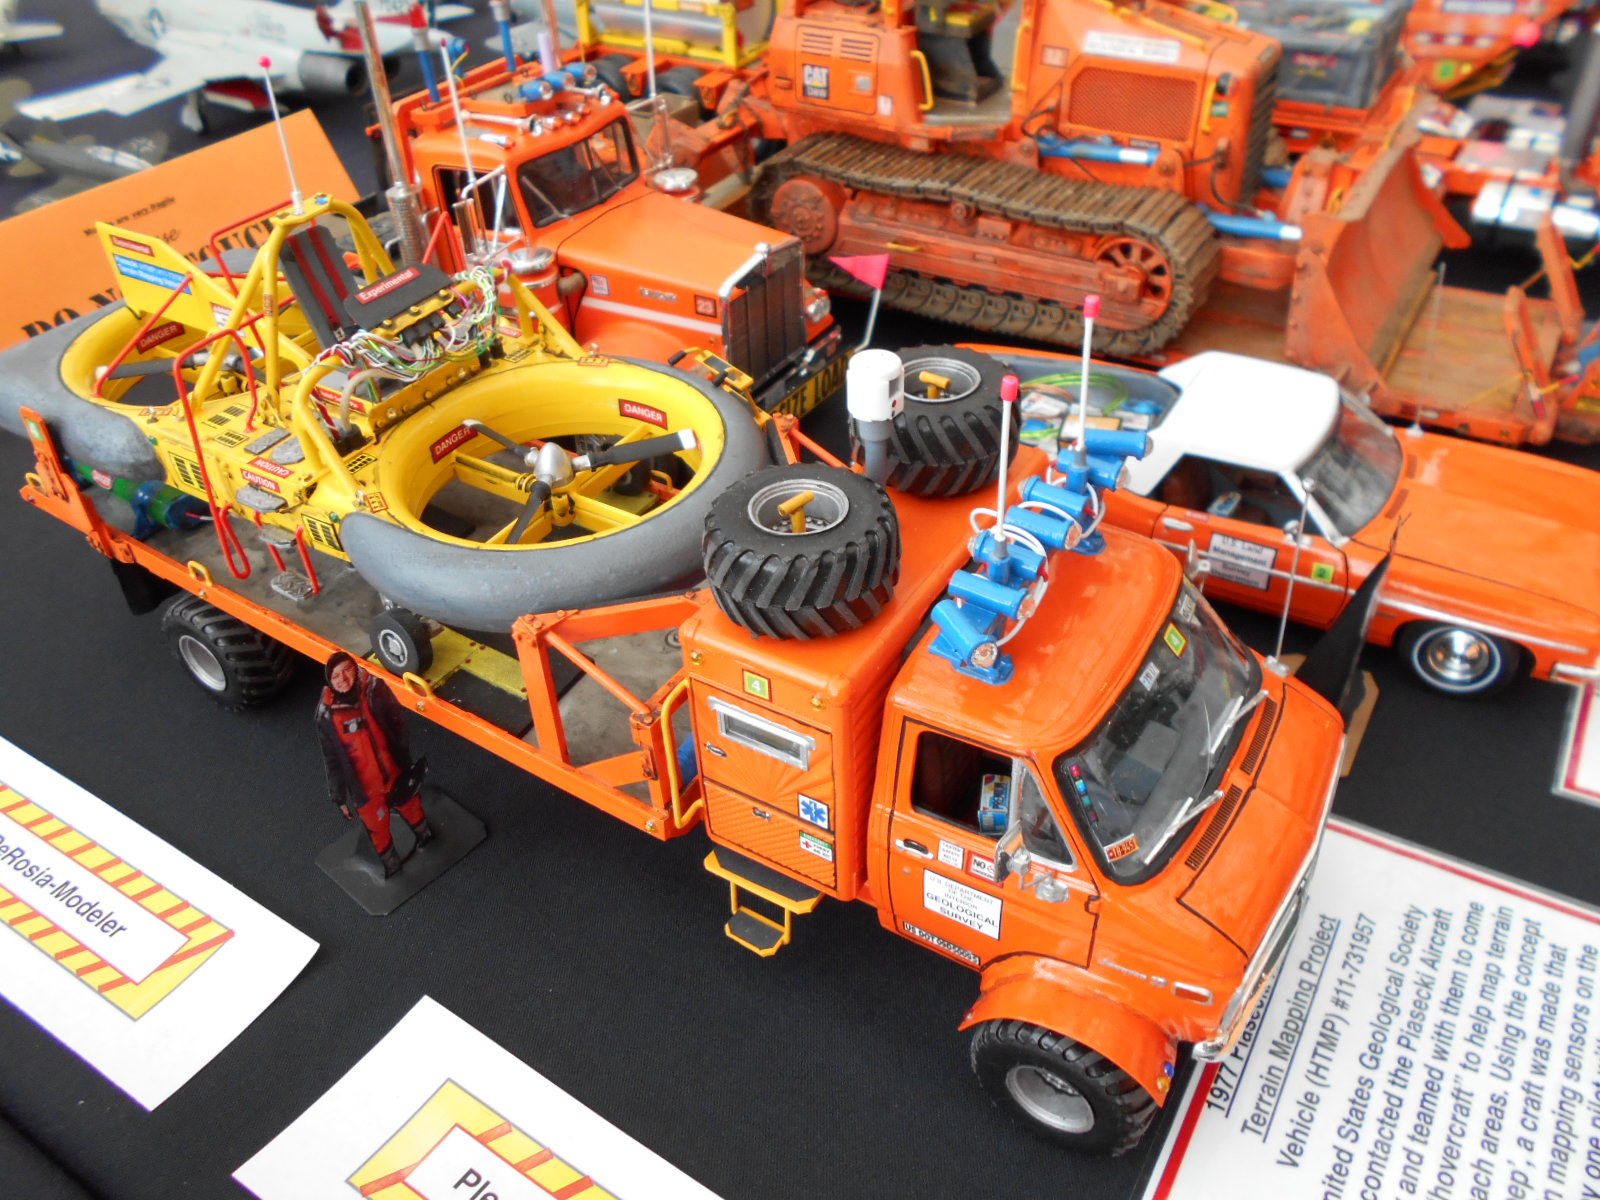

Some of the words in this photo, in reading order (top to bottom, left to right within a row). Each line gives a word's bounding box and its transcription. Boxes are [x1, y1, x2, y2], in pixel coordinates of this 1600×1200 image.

[803, 64, 829, 88] CAT
[360, 269, 414, 301] Experimental
[139, 325, 178, 348] DANGER
[624, 403, 663, 422] DANGER
[434, 427, 471, 455] DANGER
[242, 470, 276, 490] CAUTION
[255, 458, 290, 476] CAUTION
[1213, 546, 1267, 566] Management
[1241, 540, 1264, 554] Land
[751, 679, 761, 693] 4
[973, 858, 986, 869] NO
[926, 892, 998, 927] GEOLOGICAL
[944, 892, 978, 910] INTERIOR
[945, 879, 993, 905] DEPARTMENT
[904, 922, 917, 934] US
[919, 928, 936, 942] DOT
[940, 906, 983, 930] SURVEY
[1461, 901, 1485, 946] come
[1485, 905, 1514, 959] terrain
[1420, 907, 1454, 971] Aircraft
[1515, 917, 1544, 987] concept
[1452, 949, 1473, 967] to
[1543, 943, 1568, 979] that
[1576, 944, 1599, 973] the
[1439, 970, 1469, 1017] them
[1479, 961, 1505, 1002] map
[1576, 976, 1594, 1000] on
[1397, 970, 1437, 1052] Piasecki
[1503, 989, 1528, 1020] the
[1537, 982, 1561, 1034] made
[1240, 1063, 1285, 1136] Terrain
[1268, 977, 1318, 1062] Mapping
[1300, 913, 1337, 976] Project
[1276, 1090, 1321, 1168] Vehicle
[1305, 1012, 1350, 1088] (HTMP)
[1331, 912, 1376, 1011] #11-731957
[1337, 1076, 1374, 1144] States
[1358, 964, 1405, 1071] Geological
[1389, 904, 1428, 966] Society
[1431, 1019, 1456, 1062] with
[1464, 1004, 1496, 1048] help
[1490, 1022, 1526, 1082] Using
[1530, 1036, 1552, 1077] was
[1563, 1003, 1590, 1083] sensors
[1387, 1055, 1413, 1090] the
[1459, 1051, 1481, 1073] to
[1207, 1063, 1238, 1112] 1977
[1407, 1063, 1444, 1146] teamed
[1480, 1091, 1509, 1154] areas.
[1520, 1080, 1545, 1132] craft
[1360, 1090, 1403, 1200] contacted
[1516, 1136, 1535, 1152] a
[1547, 1085, 1584, 1185] mapping
[1399, 1147, 1425, 1195] and
